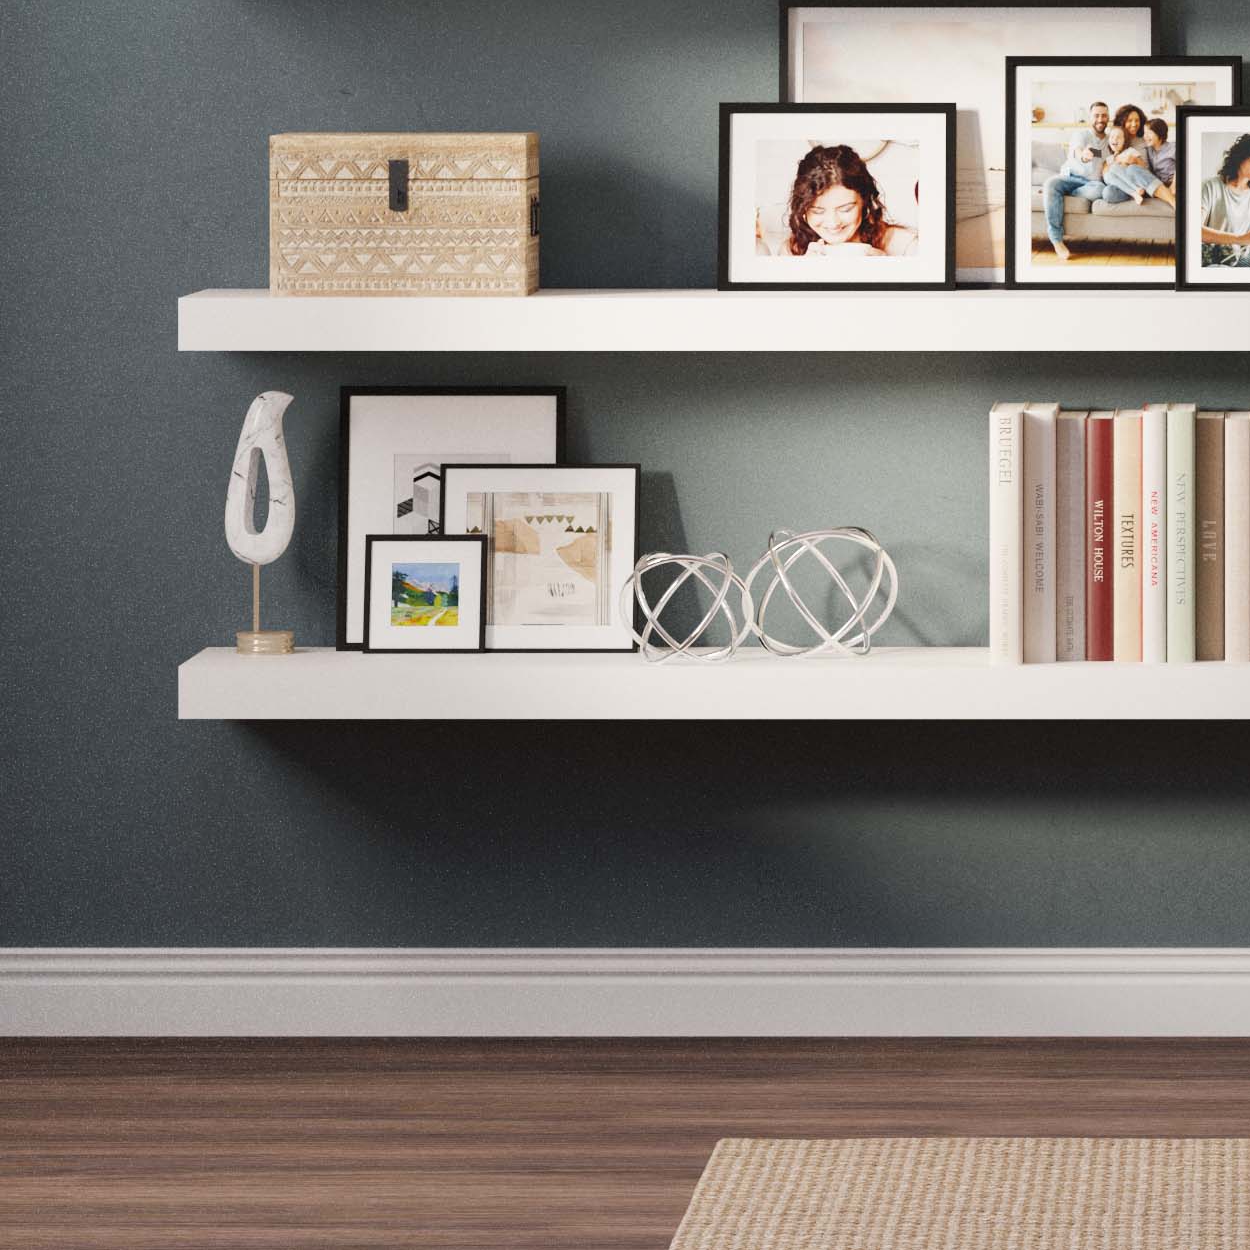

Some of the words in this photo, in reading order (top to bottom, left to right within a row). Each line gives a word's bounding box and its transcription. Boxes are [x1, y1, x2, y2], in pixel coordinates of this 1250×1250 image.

[999, 417, 1012, 486] BRUEGEL
[1035, 484, 1044, 536] WABI-SABI
[1151, 491, 1159, 516] NEW
[1176, 472, 1186, 502] NEW
[1094, 500, 1104, 542] WILTON
[1120, 513, 1135, 568] TEXTURES
[1035, 542, 1044, 593] WELCOME
[1094, 547, 1104, 582] HOUSE
[1151, 522, 1159, 587] AMERICANA
[1176, 511, 1186, 605] PERSPECTIVES
